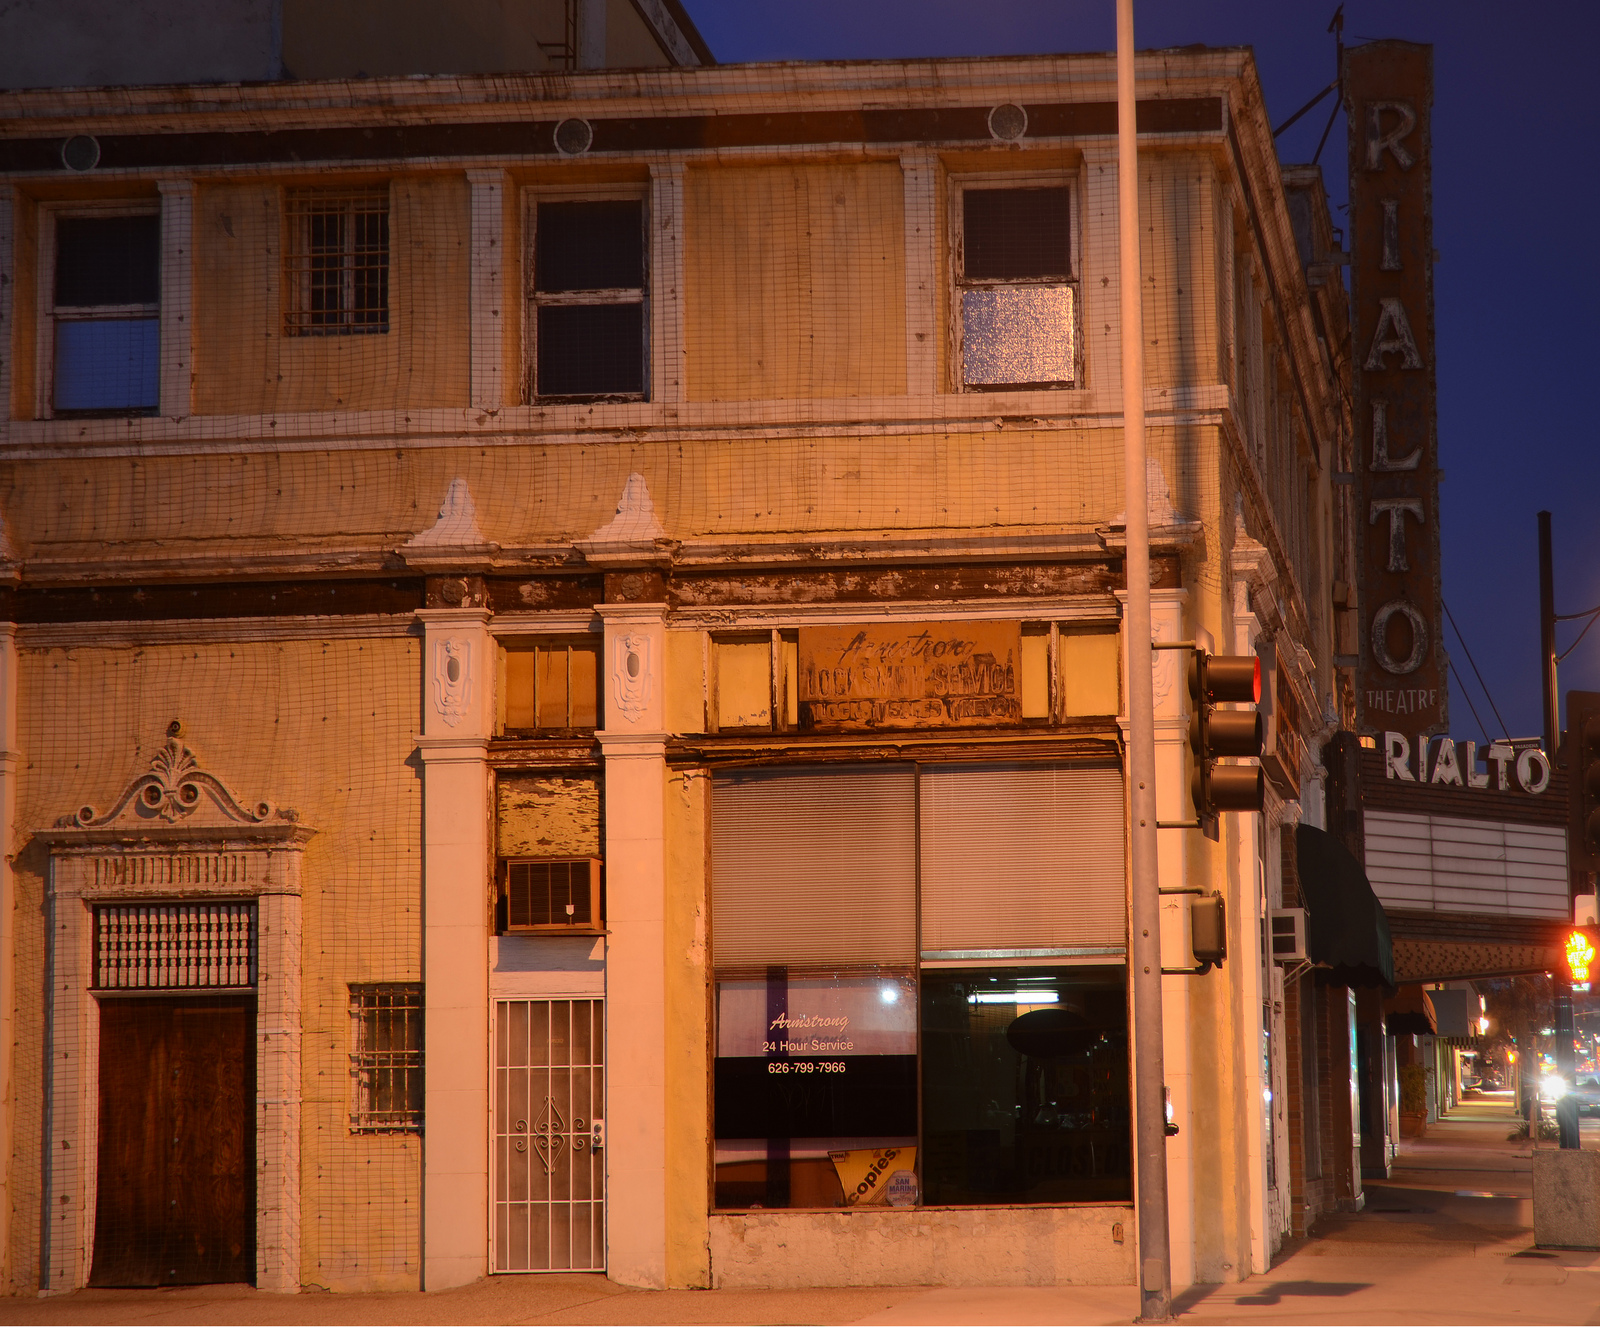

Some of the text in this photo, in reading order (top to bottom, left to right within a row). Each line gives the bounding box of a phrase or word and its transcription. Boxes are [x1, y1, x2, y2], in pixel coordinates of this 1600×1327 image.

[1363, 101, 1428, 675] RIALTO
[1366, 689, 1437, 715] THEATRE
[1384, 731, 1551, 794] RIALTO
[769, 1012, 850, 1032] Armstrong
[762, 1039, 854, 1052] 24 Hour Service
[768, 1062, 846, 1074] 626-799-7966
[847, 1149, 897, 1206] copies
[889, 1185, 917, 1193] MARINO
